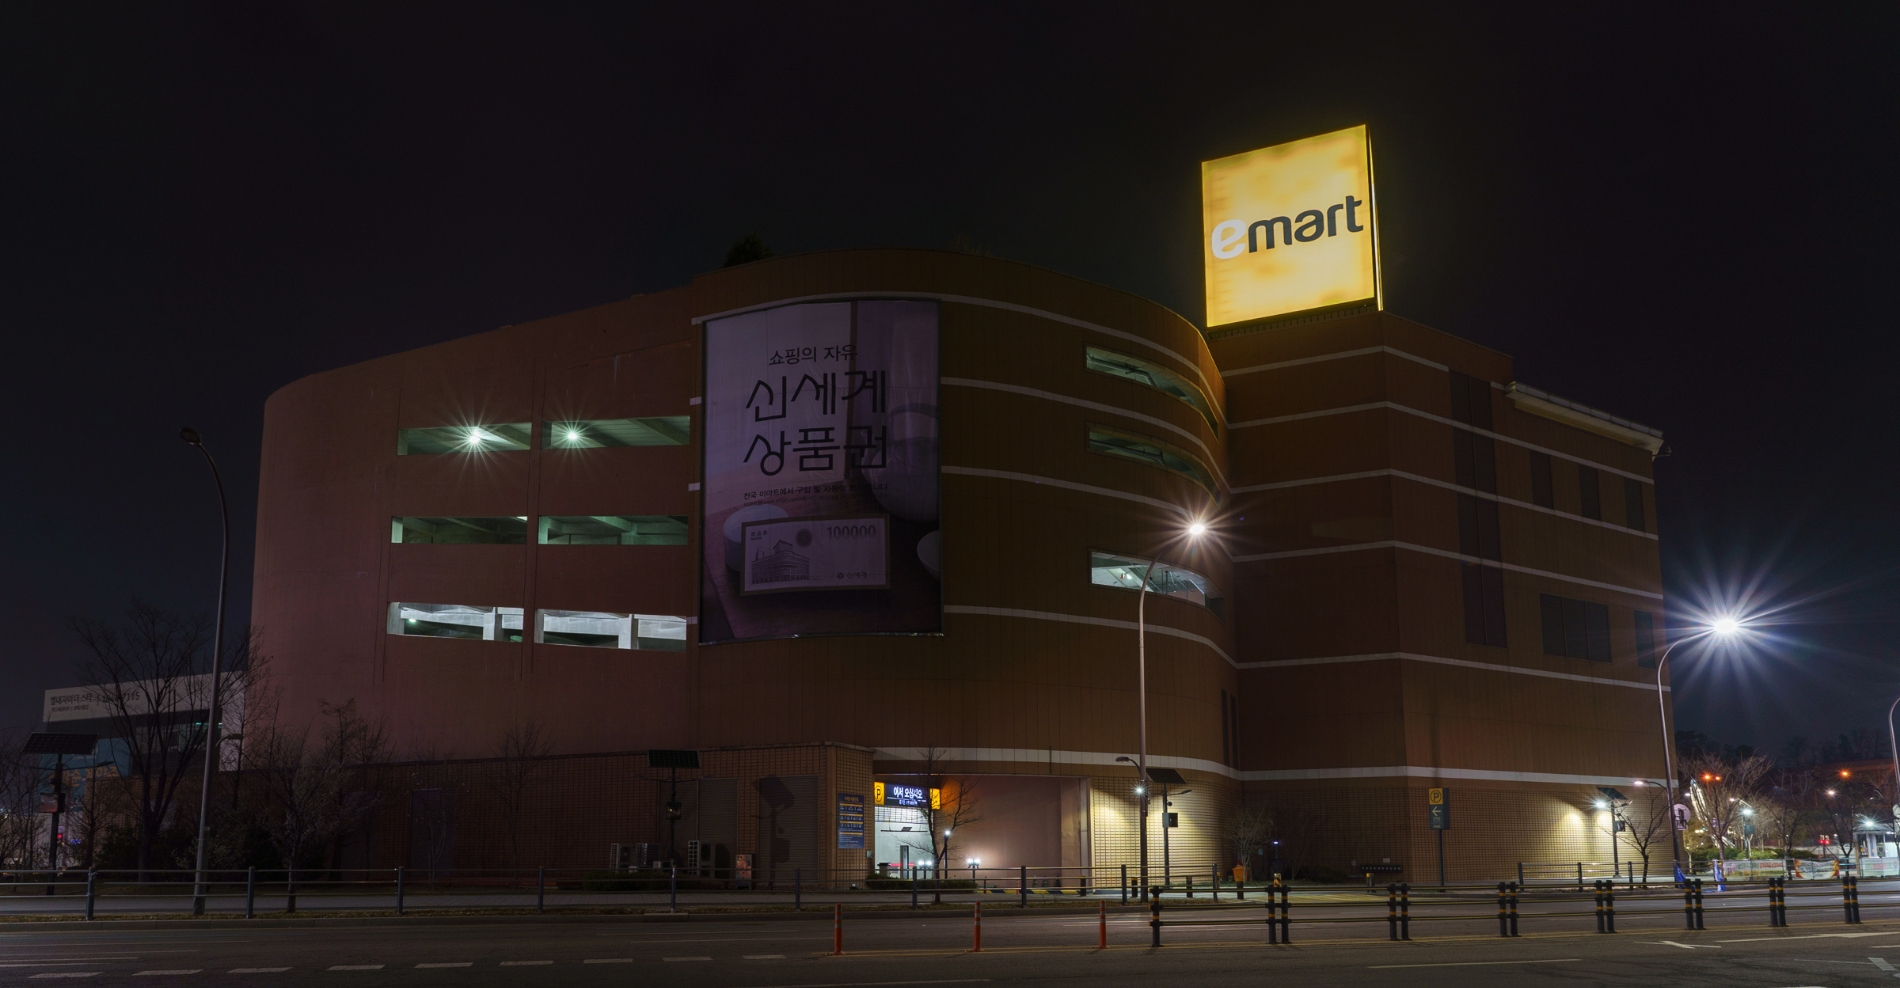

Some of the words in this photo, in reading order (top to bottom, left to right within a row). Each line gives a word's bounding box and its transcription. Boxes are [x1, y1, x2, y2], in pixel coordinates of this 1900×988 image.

[1211, 195, 1364, 260] emart
[769, 346, 817, 366] 쇼핑의
[823, 344, 858, 362] 자유
[745, 370, 887, 422] 신세계
[743, 425, 887, 476] 상품권
[759, 488, 794, 498] 이마트에서
[826, 525, 877, 541] 100000
[893, 786, 904, 798] 어서
